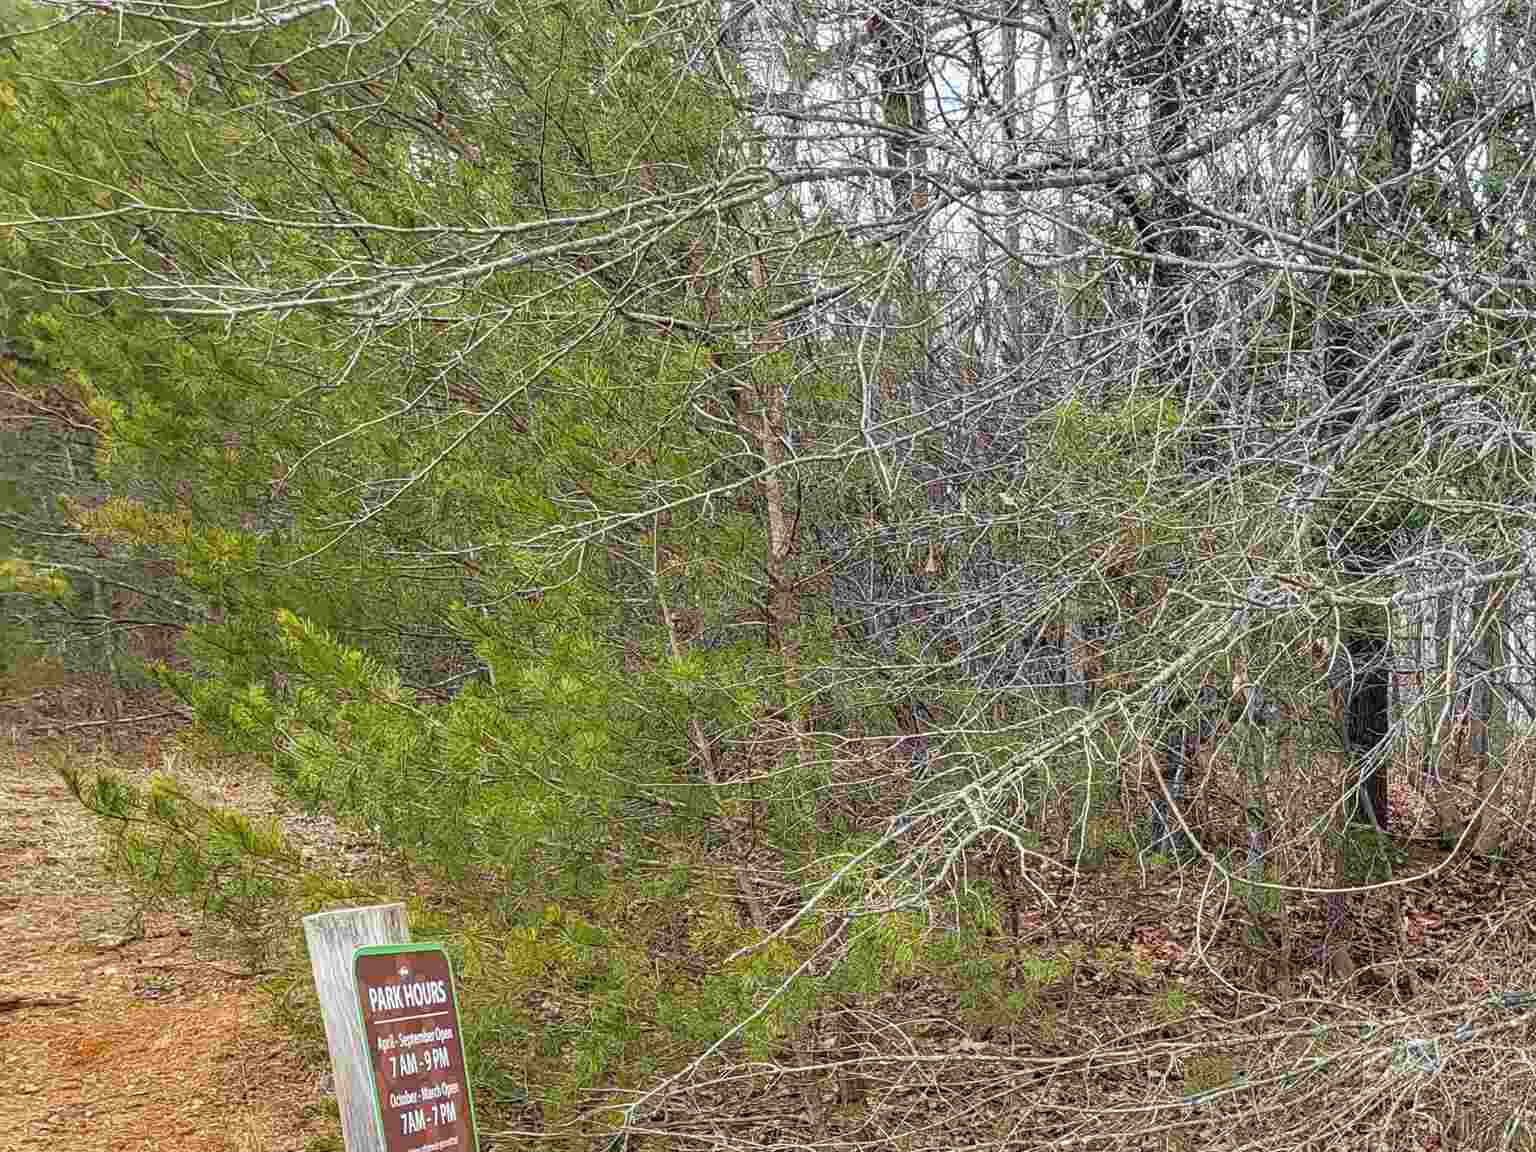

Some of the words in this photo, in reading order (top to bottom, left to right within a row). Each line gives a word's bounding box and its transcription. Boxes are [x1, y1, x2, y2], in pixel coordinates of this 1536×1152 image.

[368, 986, 404, 1012] PARK
[404, 981, 447, 1008] HOURS
[389, 1057, 397, 1078] 7
[400, 1052, 418, 1077] AM
[424, 1050, 432, 1071] 9
[432, 1047, 450, 1068] PM
[431, 1105, 440, 1127] 7
[440, 1102, 457, 1124] PM
